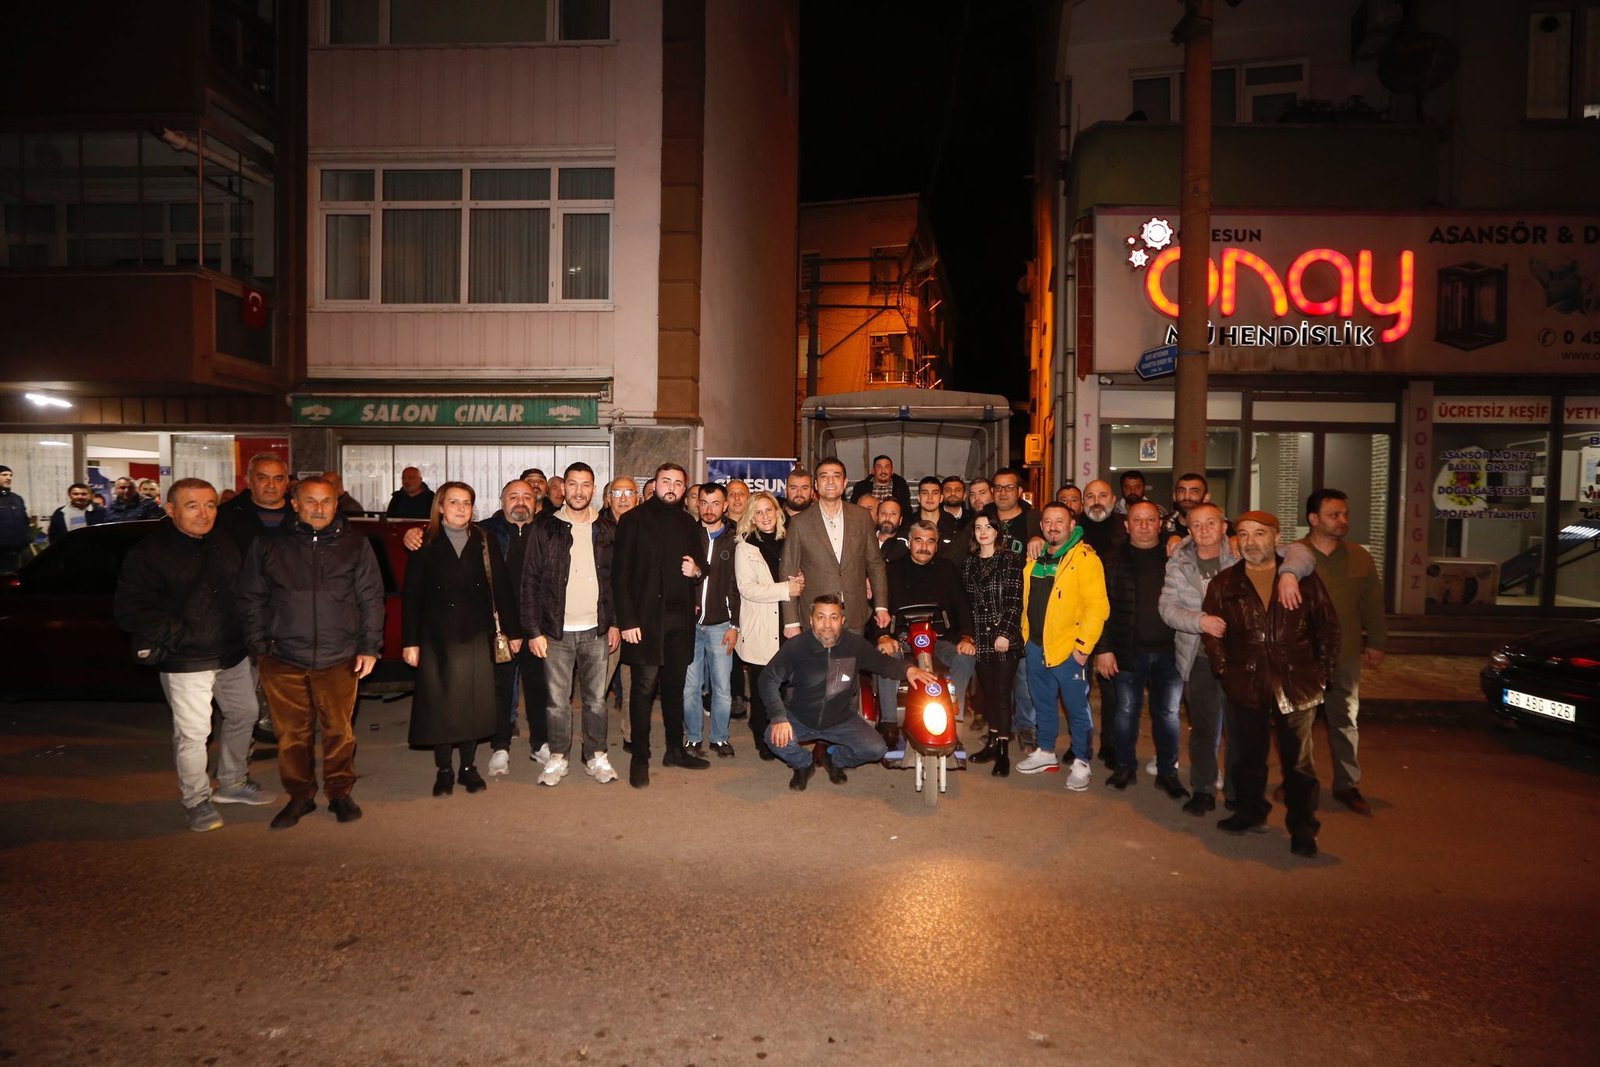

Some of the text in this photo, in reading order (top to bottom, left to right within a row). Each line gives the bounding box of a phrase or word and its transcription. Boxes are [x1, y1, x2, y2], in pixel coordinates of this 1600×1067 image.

[1428, 221, 1547, 245] ASANSÖR
[1557, 226, 1574, 244] &
[1145, 246, 1414, 343] onay
[361, 404, 525, 425] SALON ÇINAR
[1438, 403, 1549, 422] ÜCRETSİZ KEŞİF
[1490, 450, 1537, 461] MONTAJ
[1485, 463, 1530, 473] ONARIM
[1410, 407, 1429, 590] DOĞALGAZ
[1435, 509, 1470, 520] PROJE
[1550, 702, 1572, 719] 926
